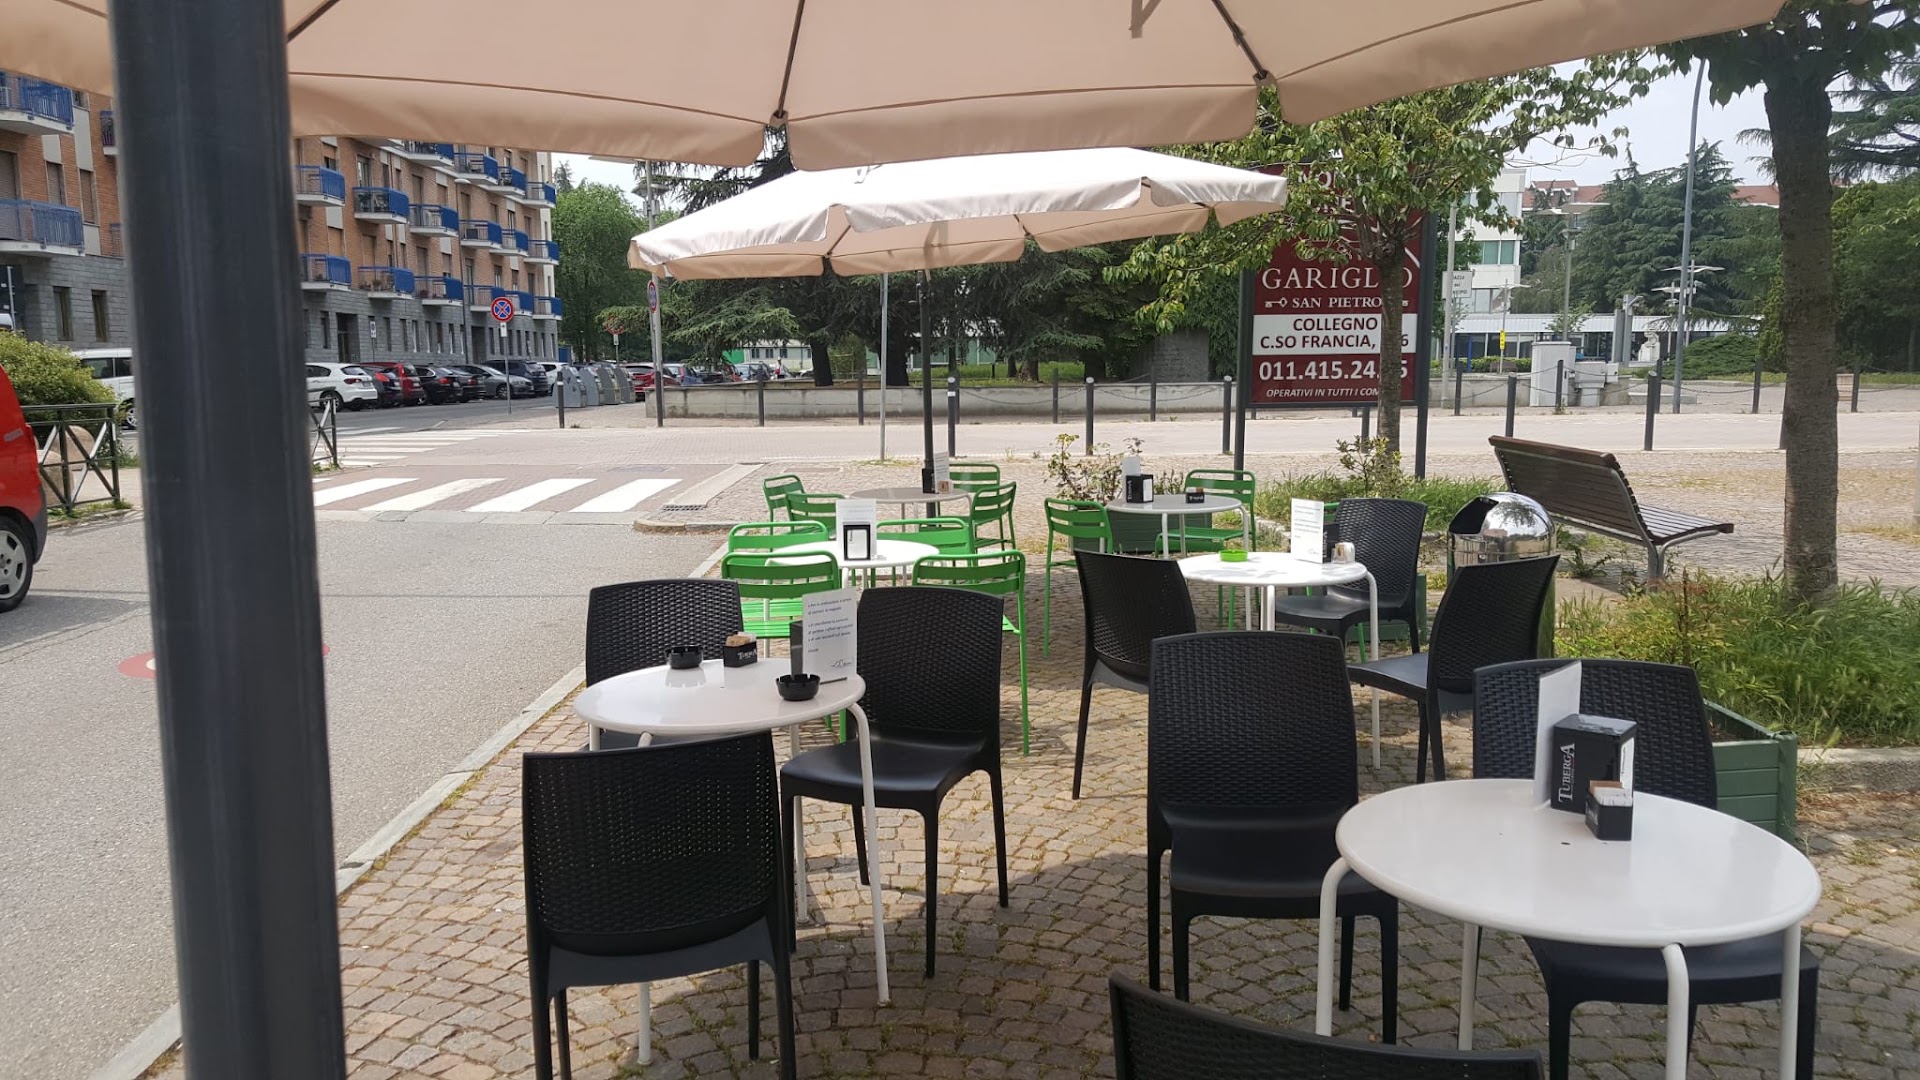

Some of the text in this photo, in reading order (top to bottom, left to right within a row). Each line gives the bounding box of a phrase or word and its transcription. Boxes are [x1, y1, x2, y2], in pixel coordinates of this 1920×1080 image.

[1292, 296, 1382, 308] SAN PIETRO
[1293, 317, 1378, 331] COLLEGNO
[1260, 334, 1375, 350] C.SO FRANCIA,
[1259, 359, 1408, 381] 011.415.24.5
[1266, 388, 1312, 398] OPERATIVI
[1315, 388, 1326, 397] IN
[1327, 388, 1353, 397] TUTTI
[1558, 743, 1575, 803] TUBERGA
